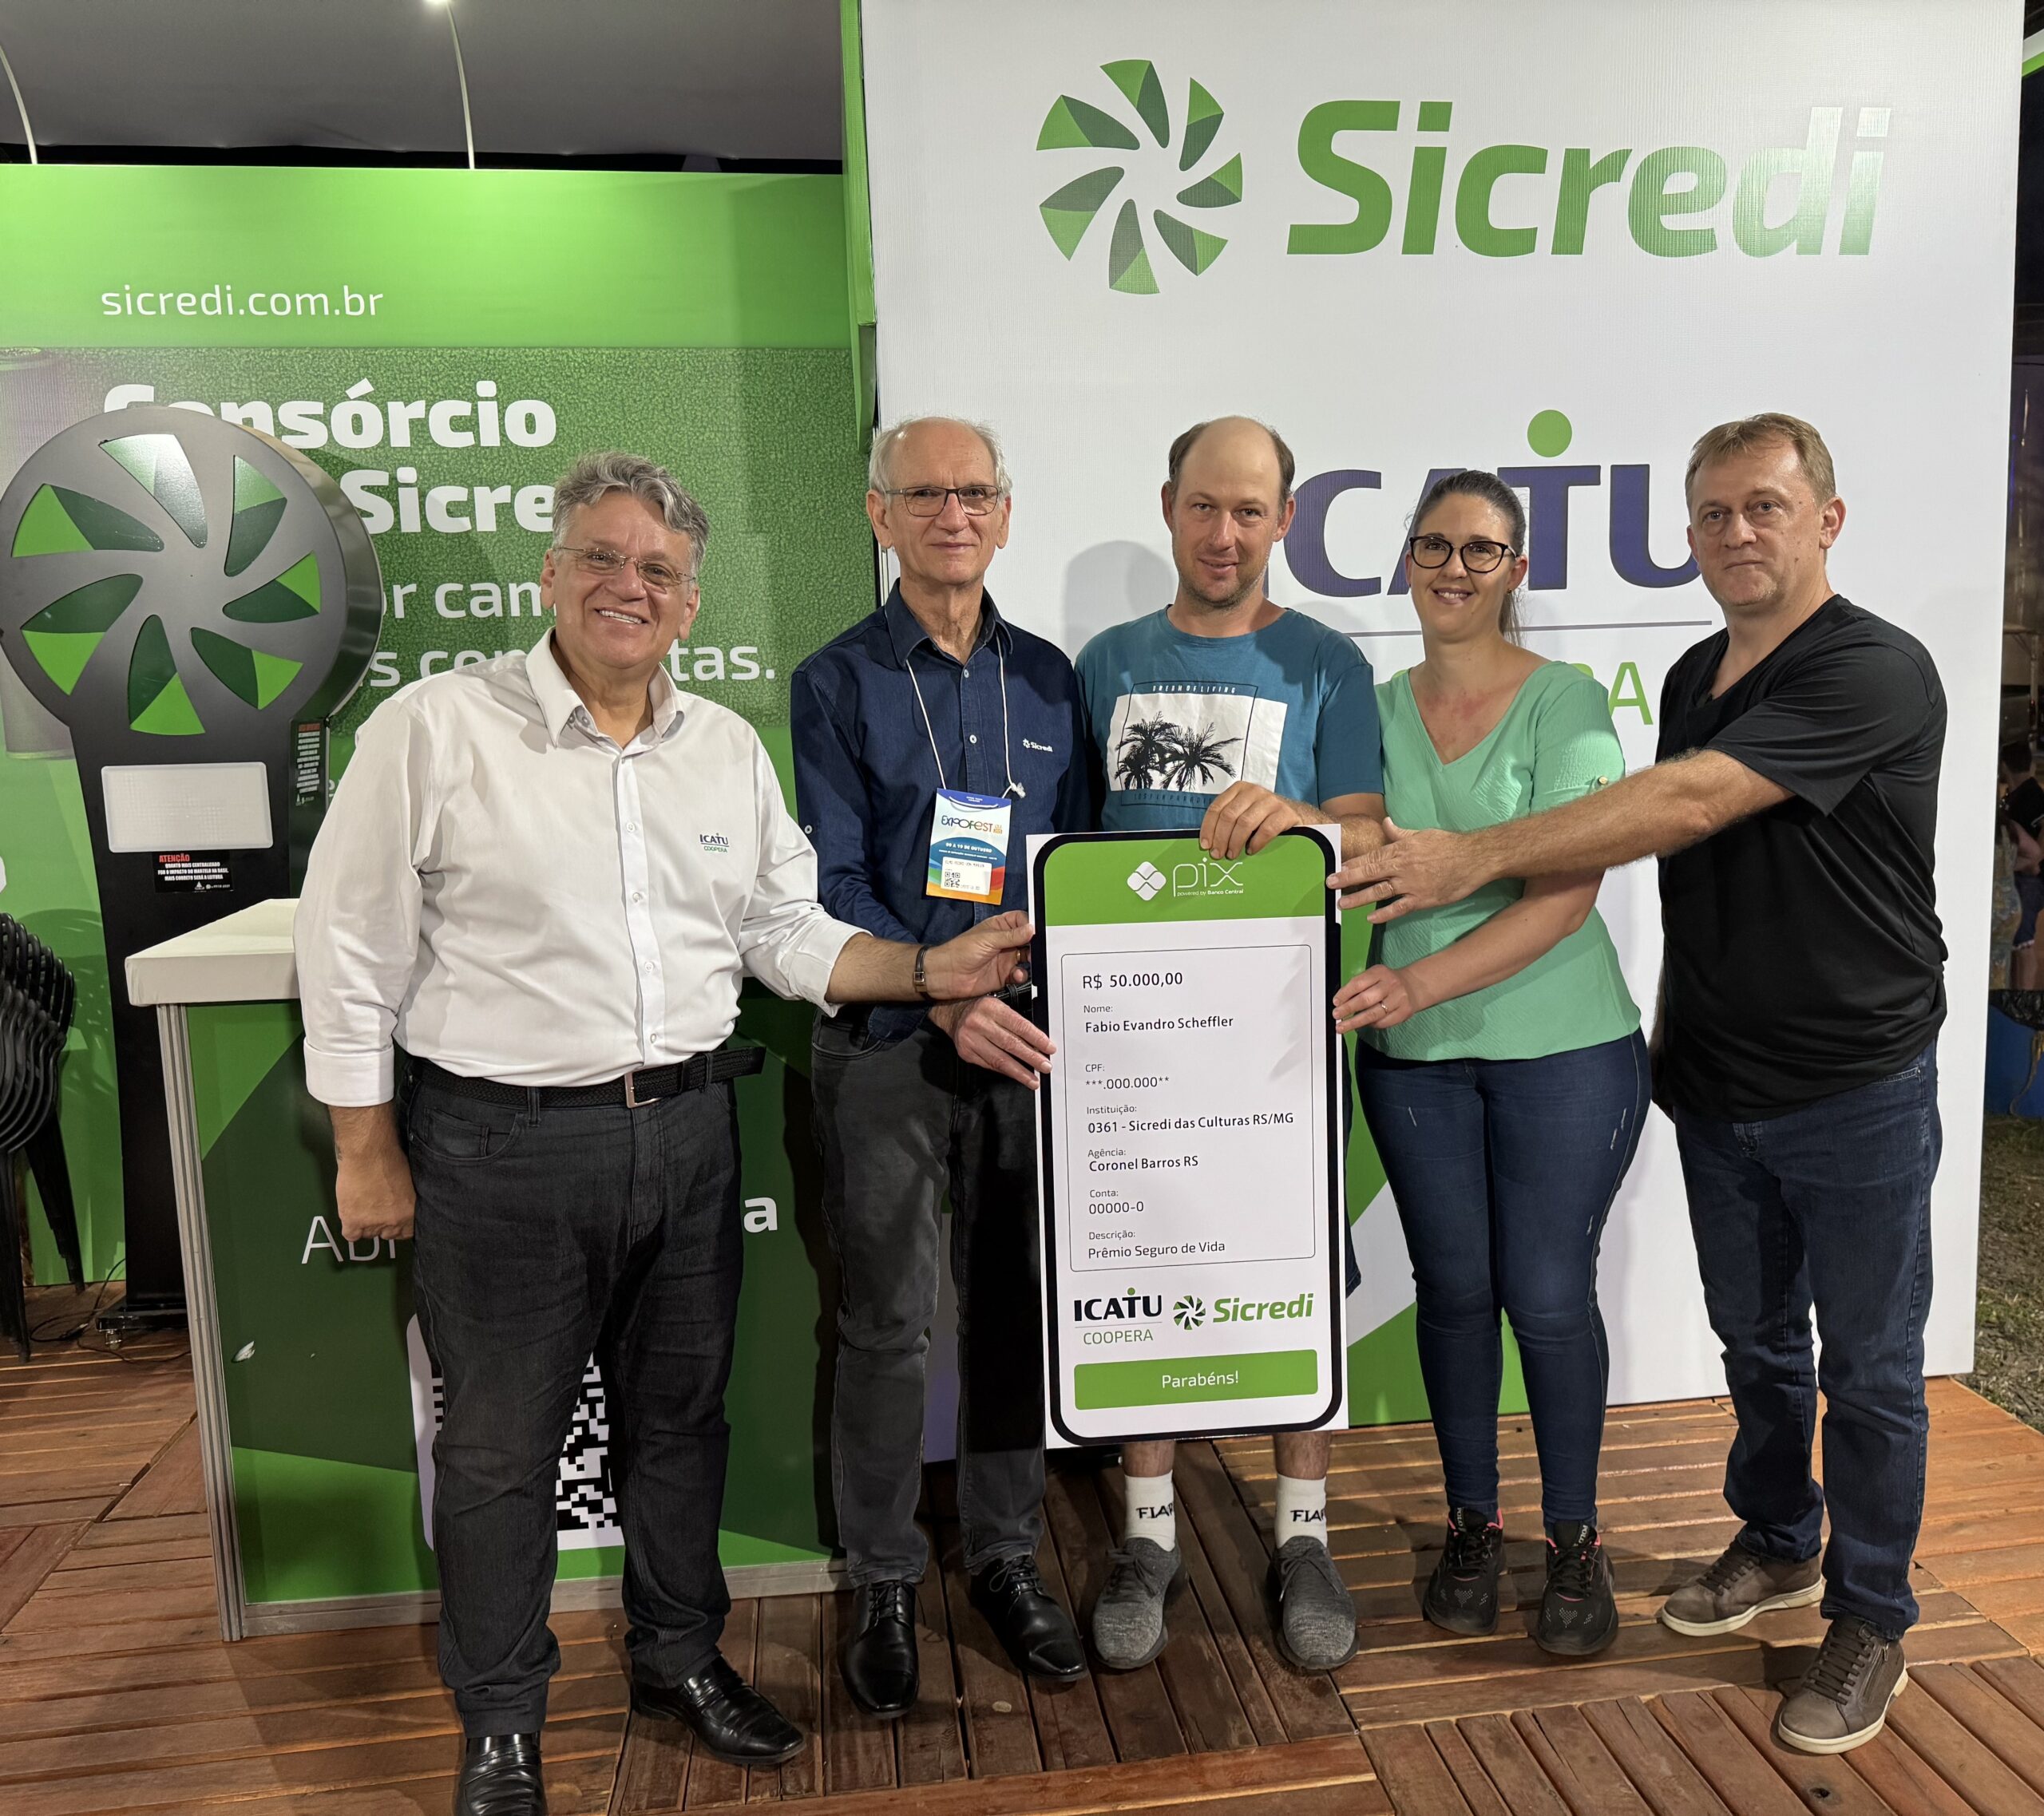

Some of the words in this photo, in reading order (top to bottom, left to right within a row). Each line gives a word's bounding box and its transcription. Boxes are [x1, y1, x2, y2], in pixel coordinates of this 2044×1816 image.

[1286, 100, 1891, 258] Sicredi
[101, 284, 384, 316] sicredi.com.br
[104, 378, 557, 449] nsórcio
[1030, 742, 1053, 753] Sicredi
[699, 833, 729, 845] ICATU
[159, 853, 190, 863] ATENÇÃO
[1173, 857, 1243, 897] pix
[1083, 974, 1103, 990] R$
[1110, 972, 1182, 987] 50.000,00
[1086, 1021, 1120, 1033] Fabio
[1123, 1019, 1175, 1031] Evandro
[1178, 1015, 1234, 1029] Scheffler
[1085, 1064, 1105, 1073] CPF:
[1087, 1105, 1137, 1115] Instituição:
[1088, 1122, 1118, 1134] 0361
[1128, 1118, 1171, 1131] Sicredi
[1174, 1118, 1195, 1130] das
[1198, 1115, 1250, 1128] Culturas
[1253, 1112, 1294, 1126] RS/MG
[1087, 1148, 1127, 1158] Agência:
[1089, 1159, 1138, 1172] Coronel
[1141, 1157, 1181, 1169] Barros
[1183, 1156, 1198, 1167] RS
[1089, 1189, 1119, 1198] Conta:
[1089, 1201, 1144, 1214] 00000-0
[1088, 1230, 1135, 1240] Descrição:
[1088, 1246, 1131, 1259] Prêmio
[1135, 1245, 1178, 1257] Seguro
[1181, 1243, 1196, 1253] de
[1198, 1240, 1226, 1252] Vida
[1074, 1287, 1163, 1322] ICATU
[1212, 1292, 1314, 1323] Sicredi
[1083, 1329, 1154, 1345] COOPERA
[1162, 1370, 1239, 1388] Parabéns!
